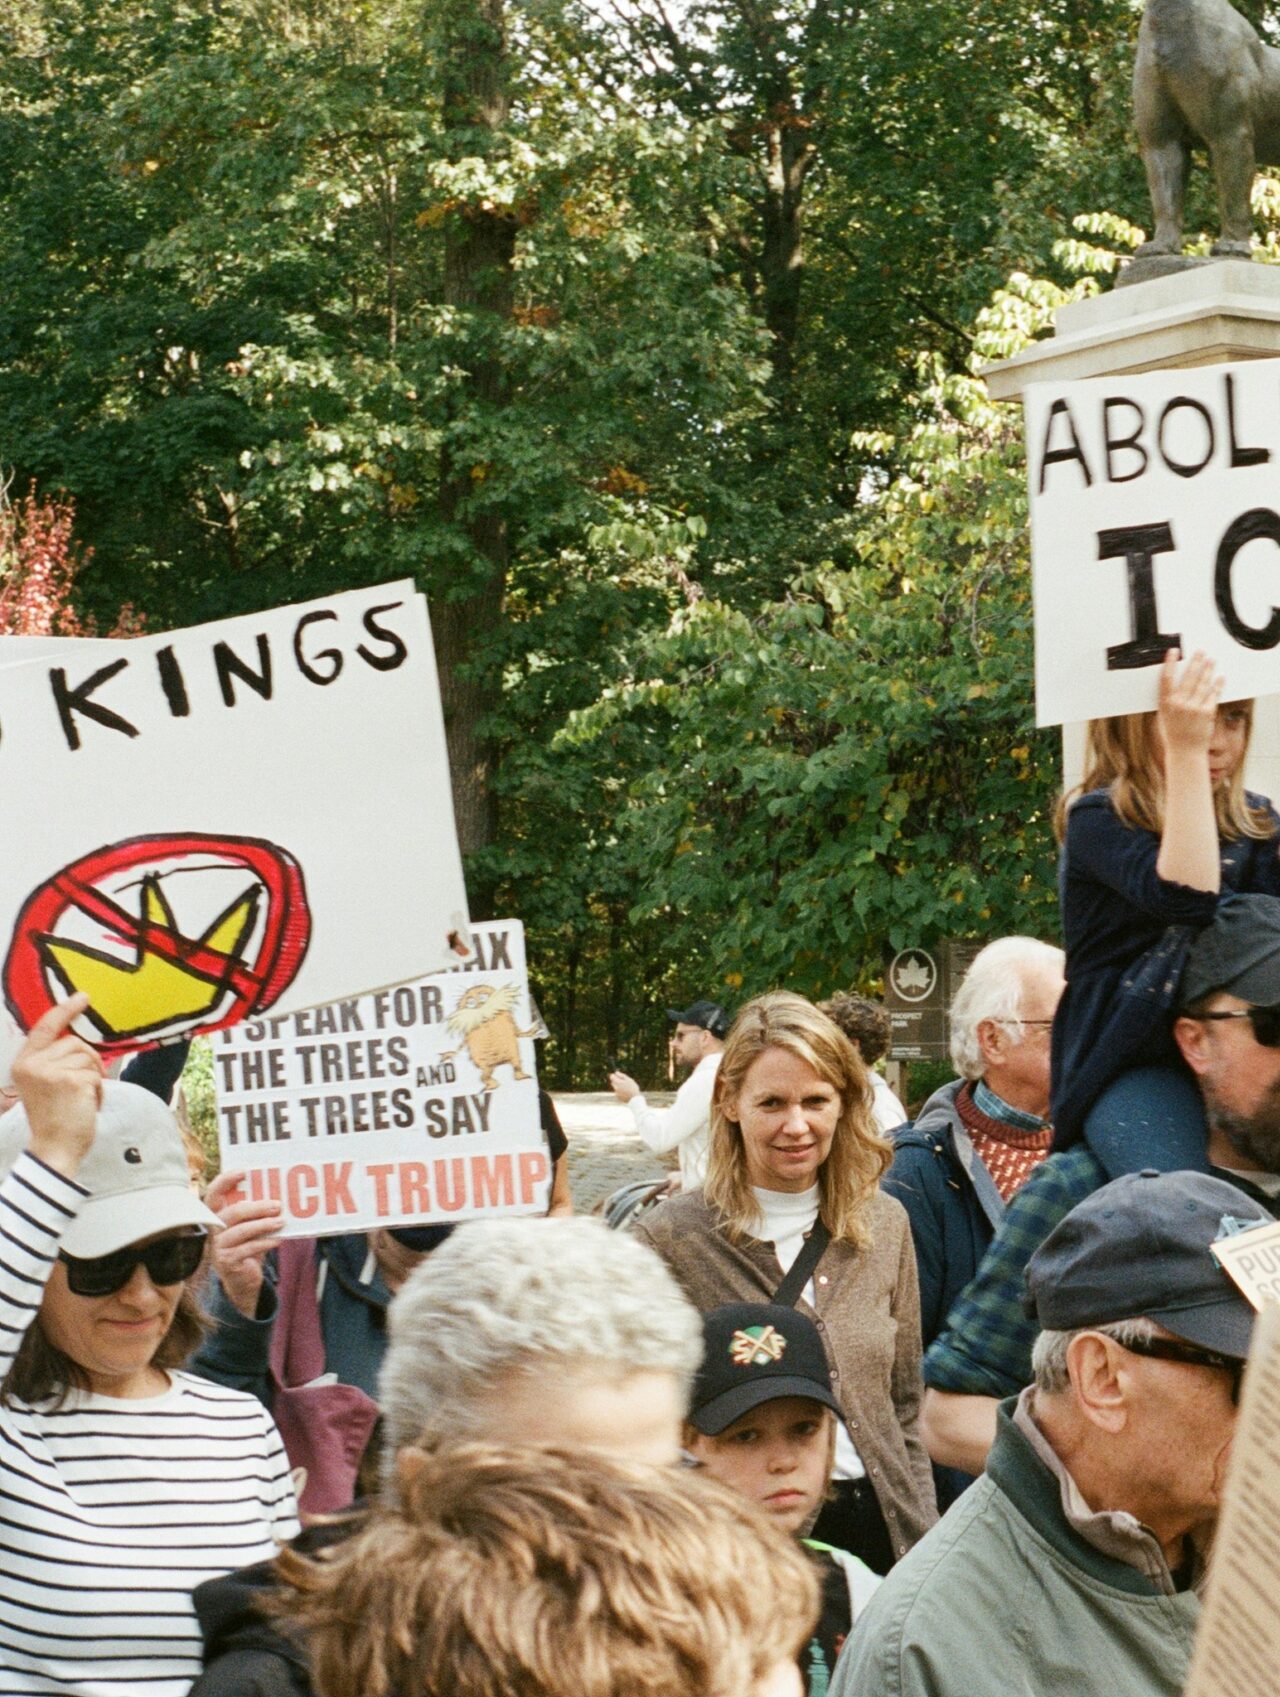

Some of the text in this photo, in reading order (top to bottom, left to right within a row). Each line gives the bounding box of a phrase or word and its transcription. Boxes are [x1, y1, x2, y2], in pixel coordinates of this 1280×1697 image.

[49, 601, 409, 751] KINGS
[373, 985, 445, 1031] FOR
[217, 1036, 457, 1093] THE TREES AND
[221, 1087, 493, 1145] THE TREES SAY
[366, 1151, 548, 1217] TRUMP
